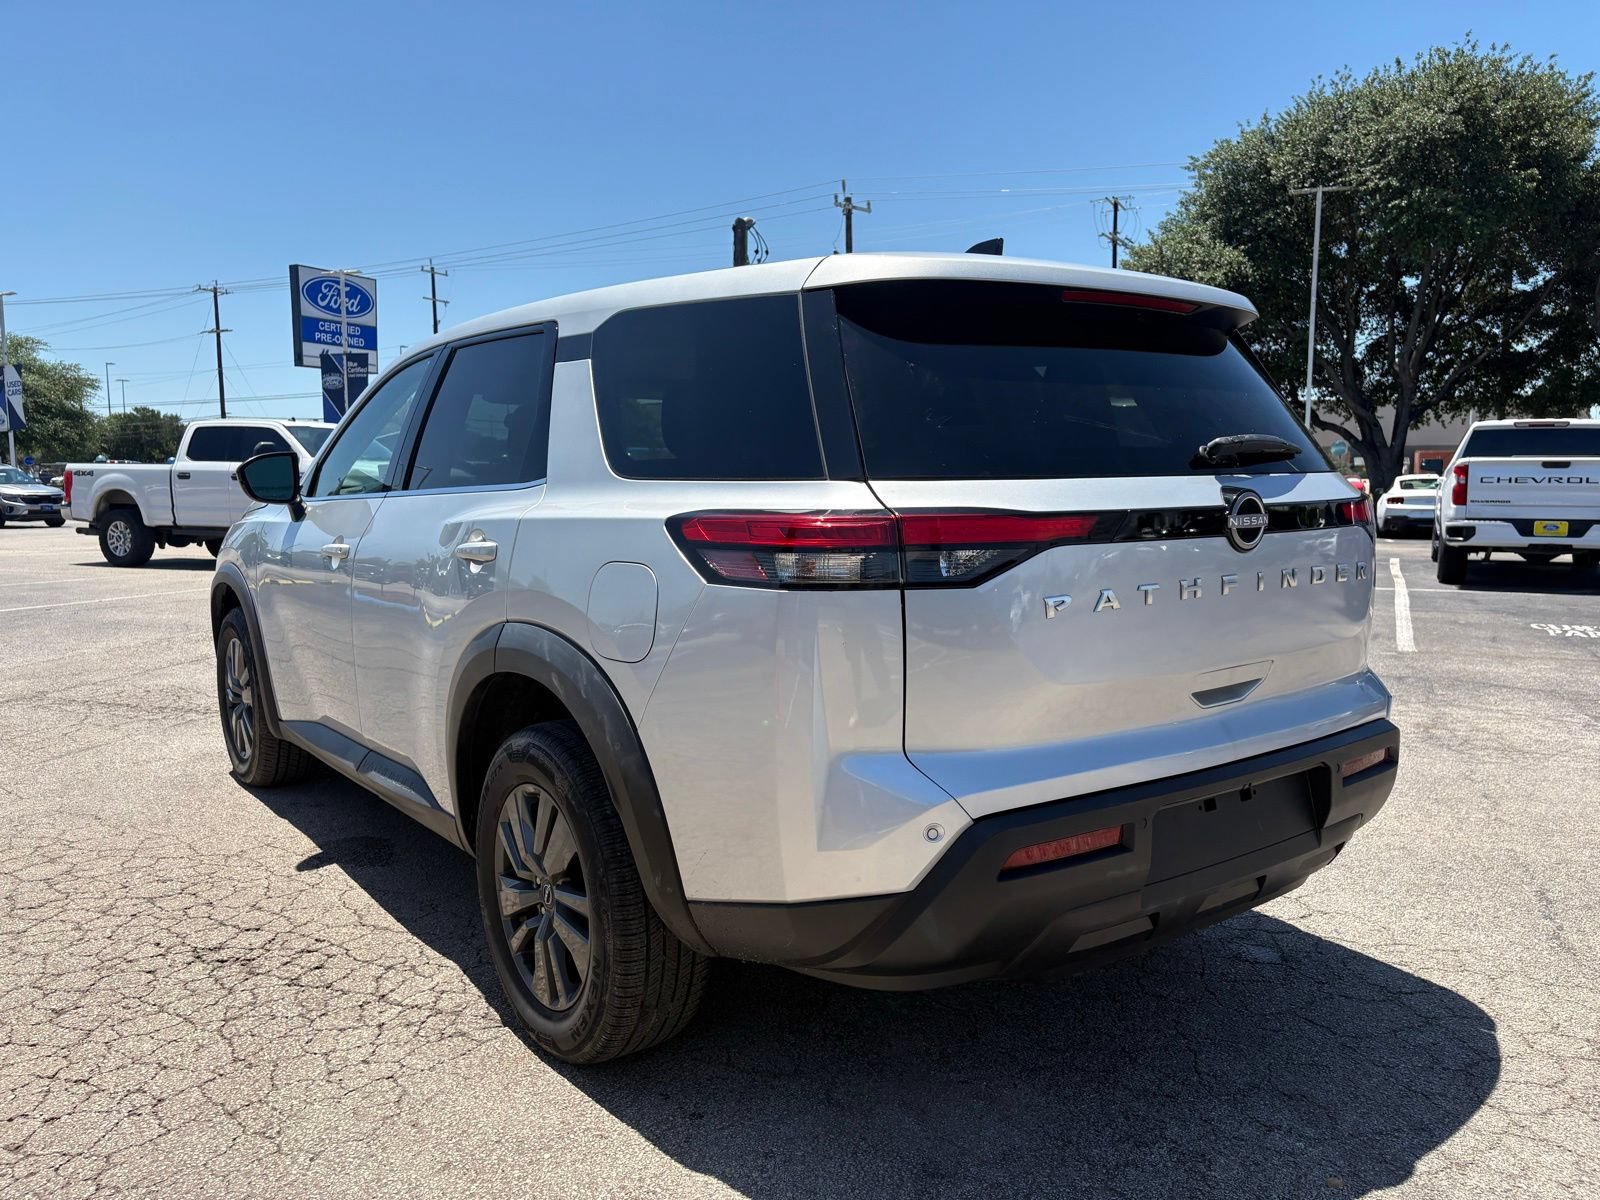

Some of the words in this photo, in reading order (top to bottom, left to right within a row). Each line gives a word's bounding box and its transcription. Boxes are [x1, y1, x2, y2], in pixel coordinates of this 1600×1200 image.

[318, 321, 361, 335] CERTIED
[315, 332, 365, 347] PRE-ONED
[7, 380, 21, 388] USED
[1480, 476, 1599, 484] CHEVROL
[1229, 515, 1268, 527] NISSAN
[1043, 561, 1368, 619] PATHFINDER
[569, 958, 602, 1041] NEXEN
